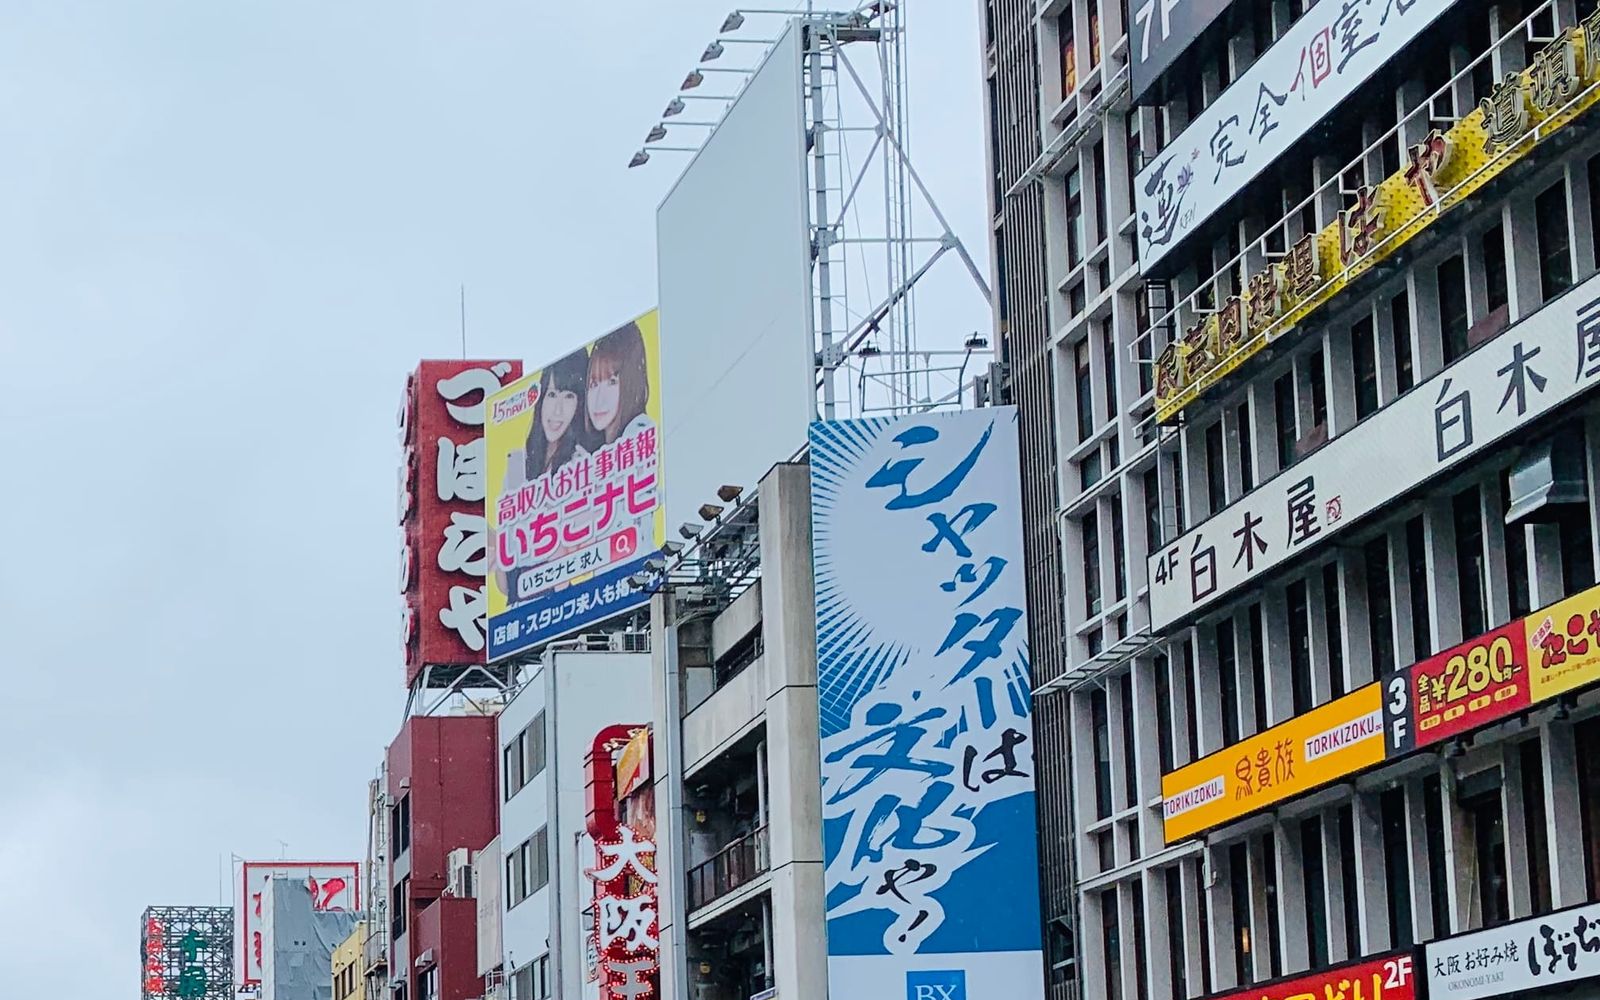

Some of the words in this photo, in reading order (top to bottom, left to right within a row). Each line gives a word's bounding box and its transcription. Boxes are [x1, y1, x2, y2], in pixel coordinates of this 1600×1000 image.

[498, 426, 656, 523] 高収入お仕事情報
[499, 474, 656, 568] いちごナビ
[1189, 475, 1317, 604] 白木屋
[521, 558, 576, 589] いちごナビ
[579, 552, 604, 569] 求人
[1154, 546, 1180, 587] 4F
[1388, 677, 1408, 749] 3F
[1418, 673, 1432, 715] 全品
[1307, 719, 1375, 757] TORIKIZOKU
[1163, 782, 1218, 815] TORIKIZOKU
[1383, 956, 1413, 990] 2F
[1434, 955, 1462, 978] 大阪
[1465, 939, 1519, 972] お好み焼
